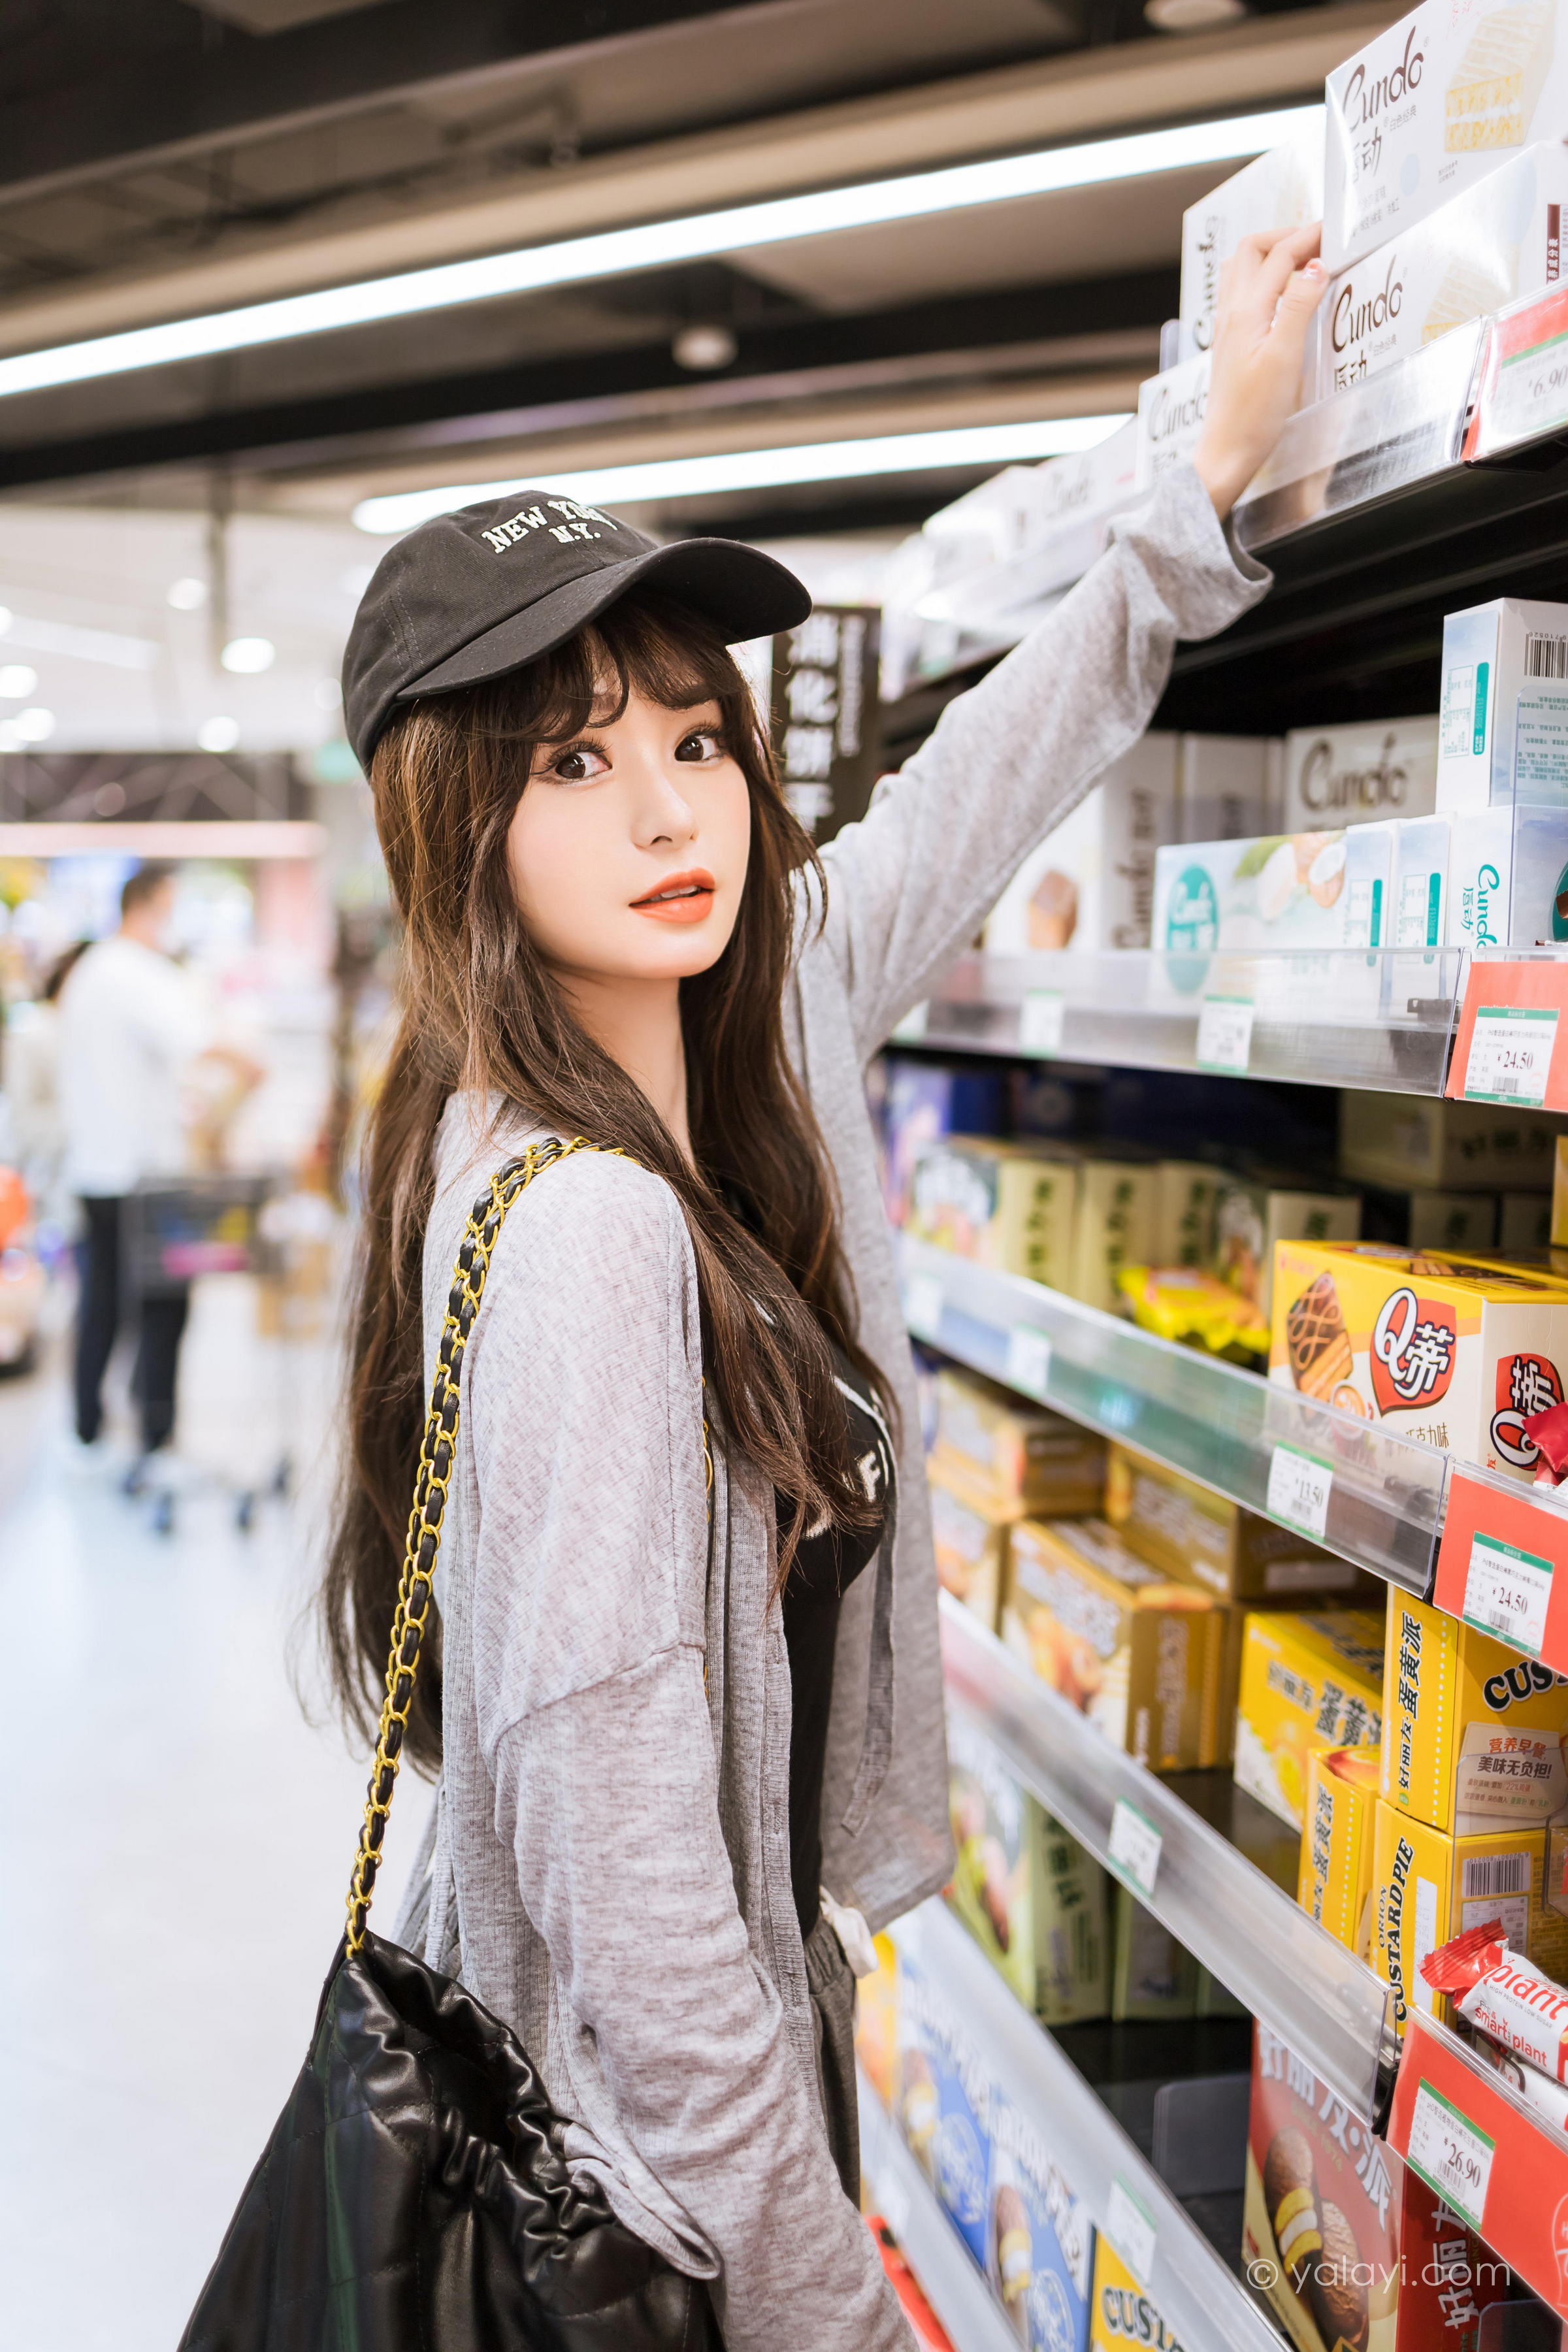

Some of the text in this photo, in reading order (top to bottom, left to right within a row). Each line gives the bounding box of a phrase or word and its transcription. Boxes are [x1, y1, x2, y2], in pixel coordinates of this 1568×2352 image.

[1343, 25, 1424, 133] Cundo
[1333, 252, 1403, 353] Cundo
[481, 506, 547, 554] NEW
[547, 522, 601, 544] N.Y.
[1503, 1050, 1534, 1070] 24.50
[1374, 1287, 1455, 1400] Q蒂
[1498, 1586, 1528, 1615] 24.50
[1483, 1658, 1568, 1712] CUS
[1377, 1885, 1388, 1949] ORION
[1483, 1963, 1568, 2021] plant
[1489, 1984, 1552, 2029] HIGH PROTEIN LOW SUGAR
[1474, 2006, 1508, 2041] smart
[1512, 2033, 1548, 2068] plant
[1447, 2142, 1482, 2189] 26.90
